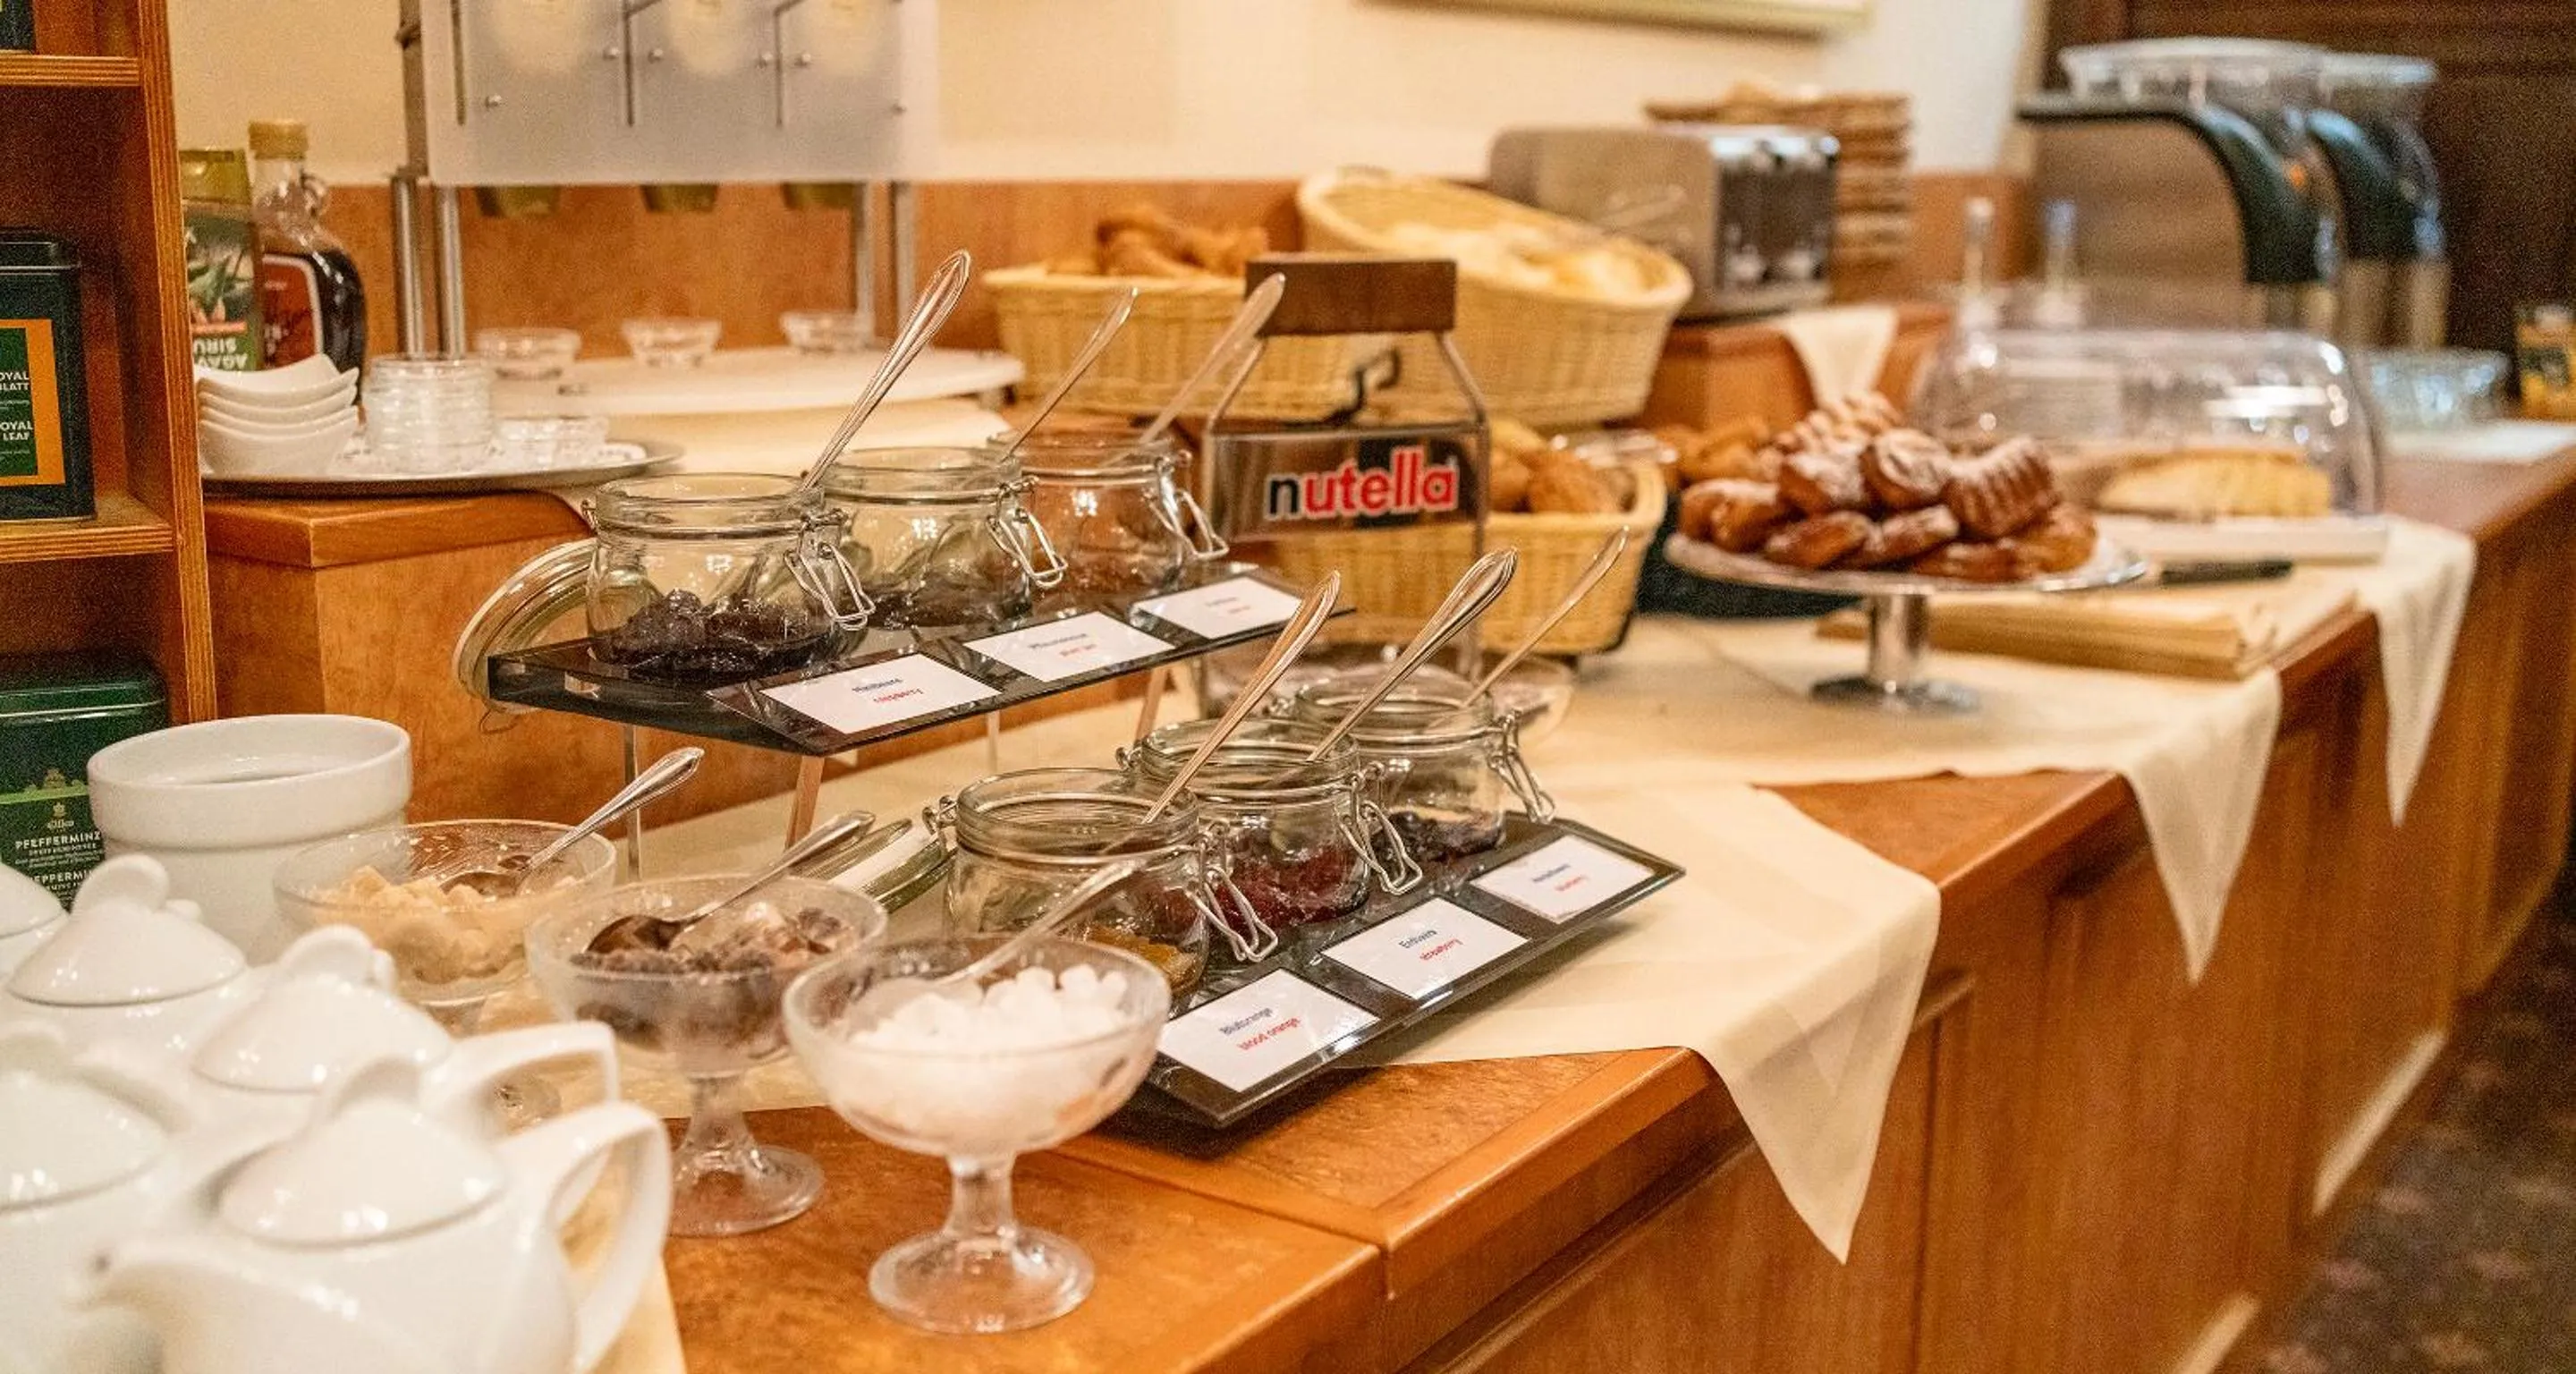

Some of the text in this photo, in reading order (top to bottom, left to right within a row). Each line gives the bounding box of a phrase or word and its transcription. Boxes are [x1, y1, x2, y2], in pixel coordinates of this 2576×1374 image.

[0, 382, 30, 391] LATT
[3, 432, 30, 441] LEAF
[1264, 447, 1459, 519] nutella
[15, 830, 102, 850] PFEFFERMINZ
